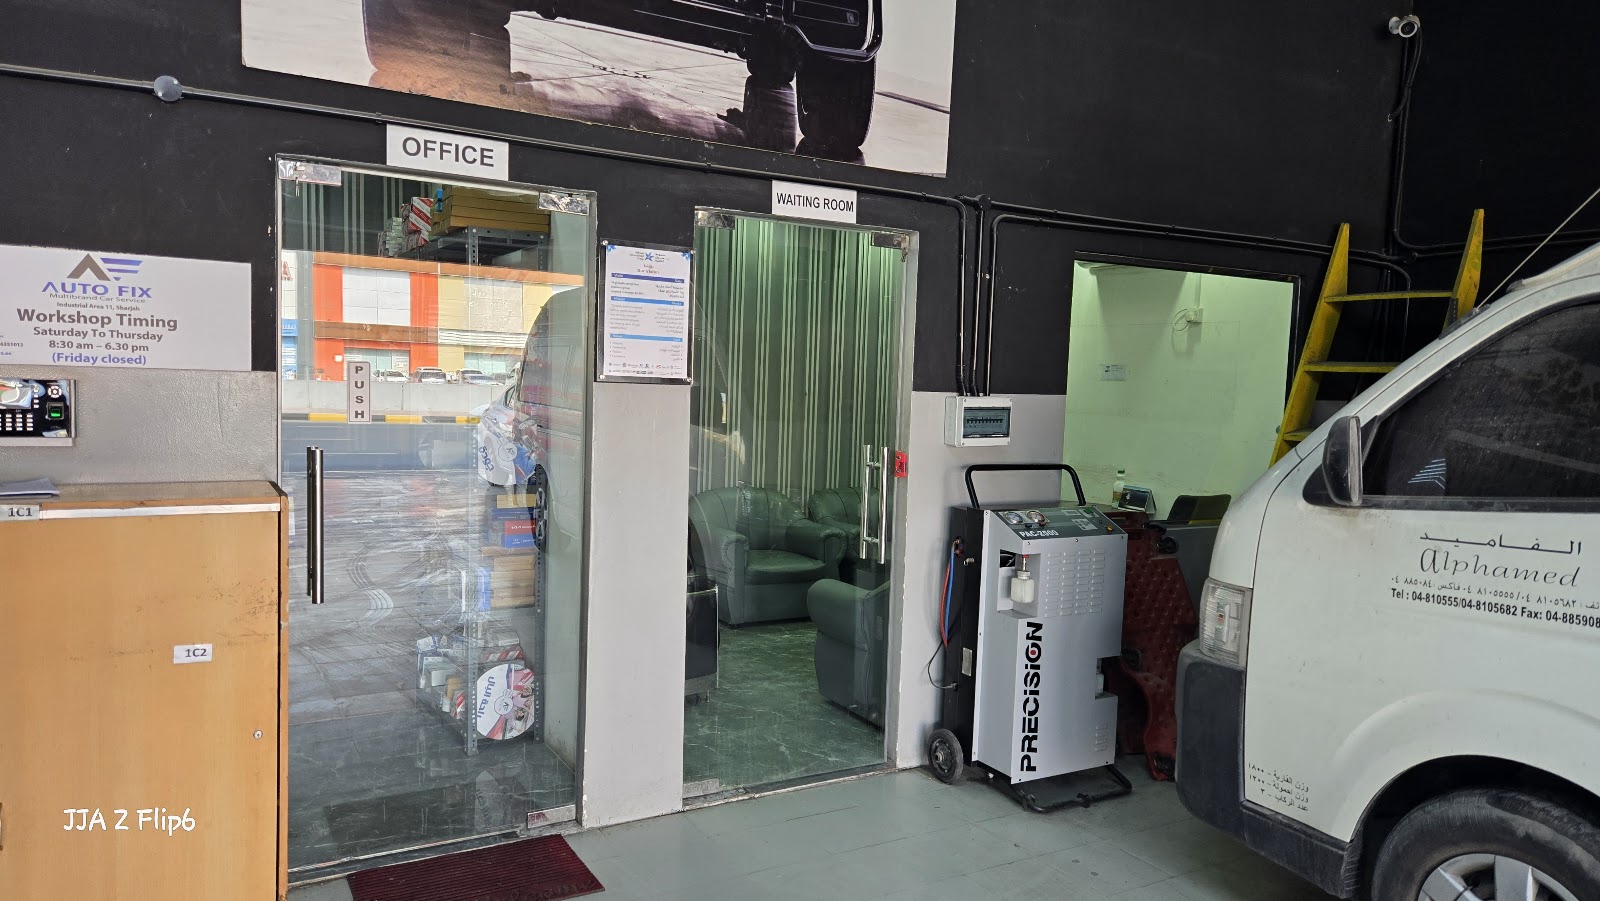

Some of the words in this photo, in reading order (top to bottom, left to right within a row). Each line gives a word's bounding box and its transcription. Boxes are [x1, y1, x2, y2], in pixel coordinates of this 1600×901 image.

[402, 136, 494, 168] OFFICE
[776, 192, 820, 209] WAITING
[823, 198, 854, 212] ROOM
[41, 281, 109, 296] AUTO
[117, 285, 153, 299] FIX
[49, 292, 98, 301] Multibrand
[115, 296, 146, 304] Service
[16, 308, 112, 328] Workshop
[115, 313, 178, 332] Timing
[33, 326, 89, 339] Saturday
[91, 328, 107, 338] To
[108, 329, 164, 343] Thursday
[48, 339, 74, 349] 8:30
[76, 341, 94, 350] am
[104, 341, 129, 351] 6.30
[131, 343, 149, 353] pm
[52, 352, 99, 365] (Friday
[101, 353, 147, 366] closed)
[354, 365, 365, 419] PUSH
[8, 507, 33, 517] 1C1
[1391, 587, 1404, 599] Tel
[1520, 606, 1542, 620] Fax:
[185, 648, 207, 658] 1C2
